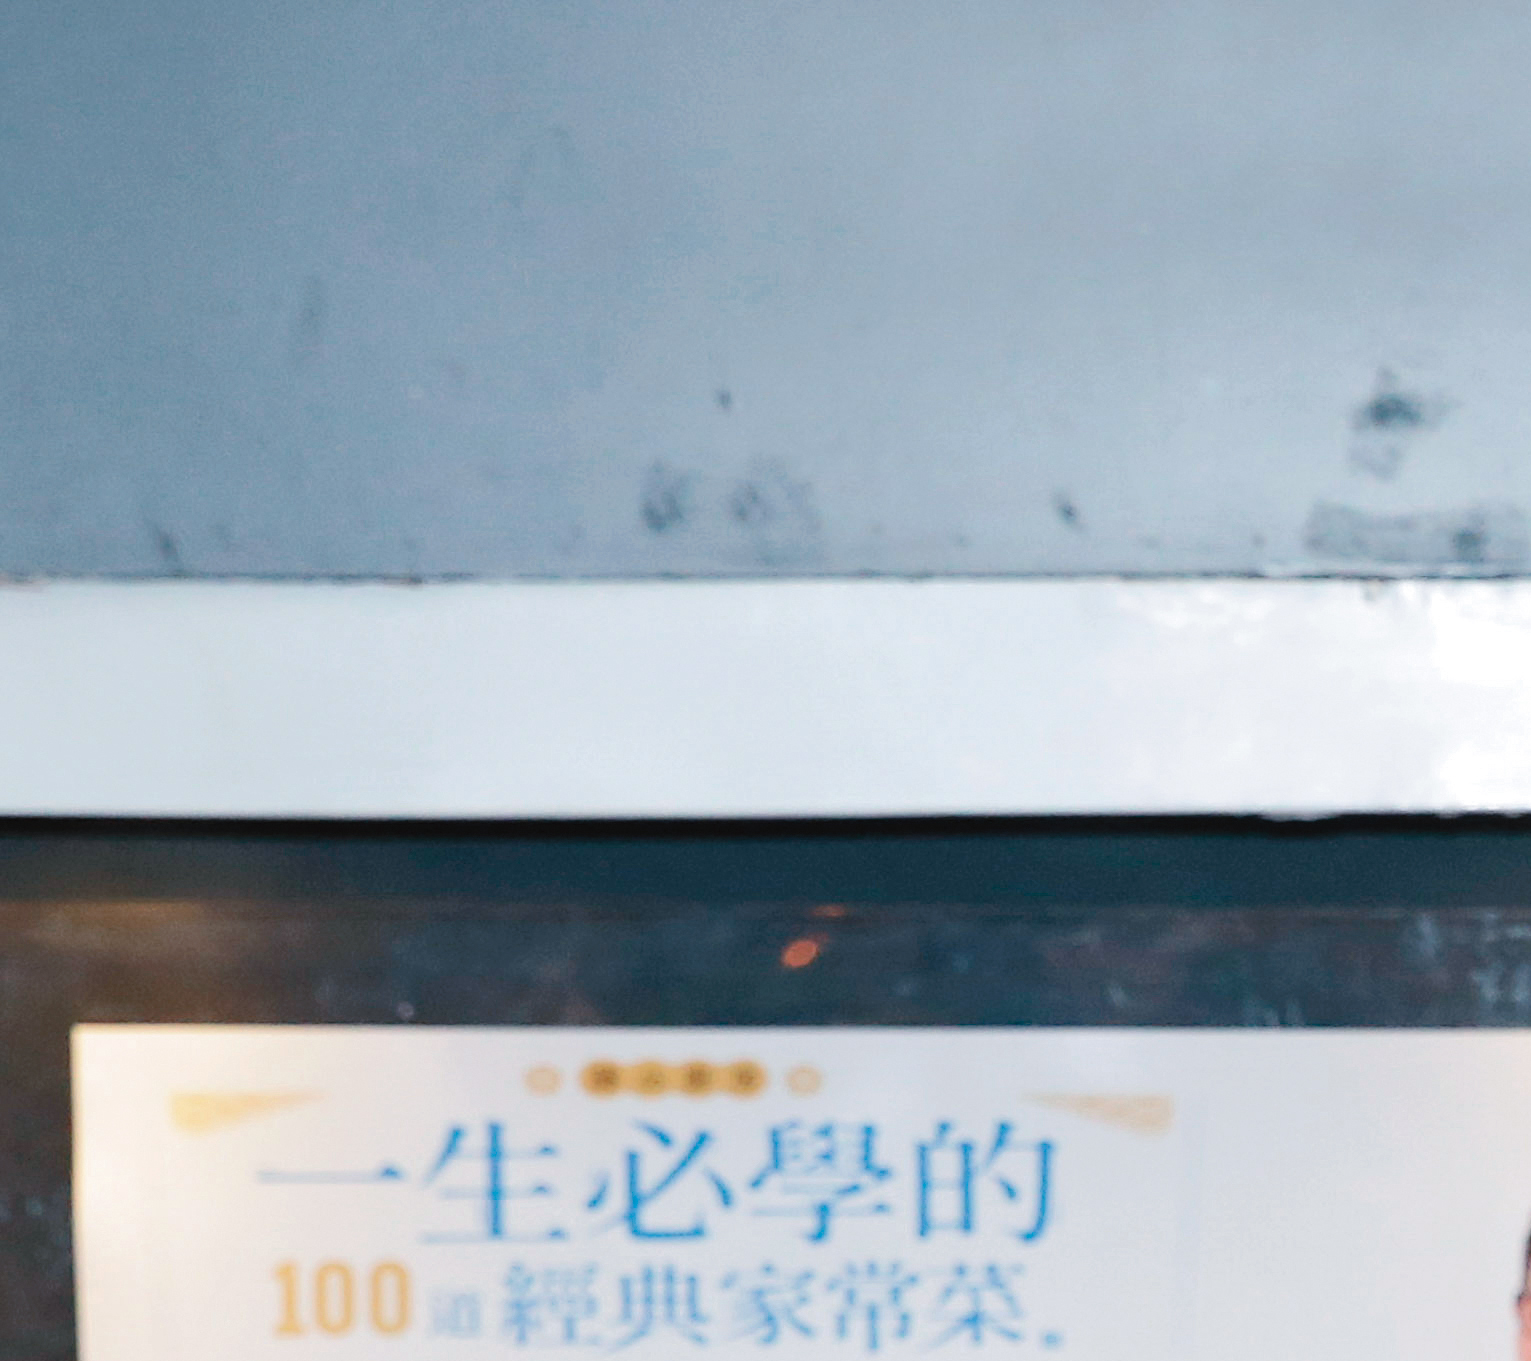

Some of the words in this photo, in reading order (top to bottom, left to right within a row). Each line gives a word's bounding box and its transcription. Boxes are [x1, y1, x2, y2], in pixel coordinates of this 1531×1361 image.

[258, 1120, 1056, 1246] 一生必學的
